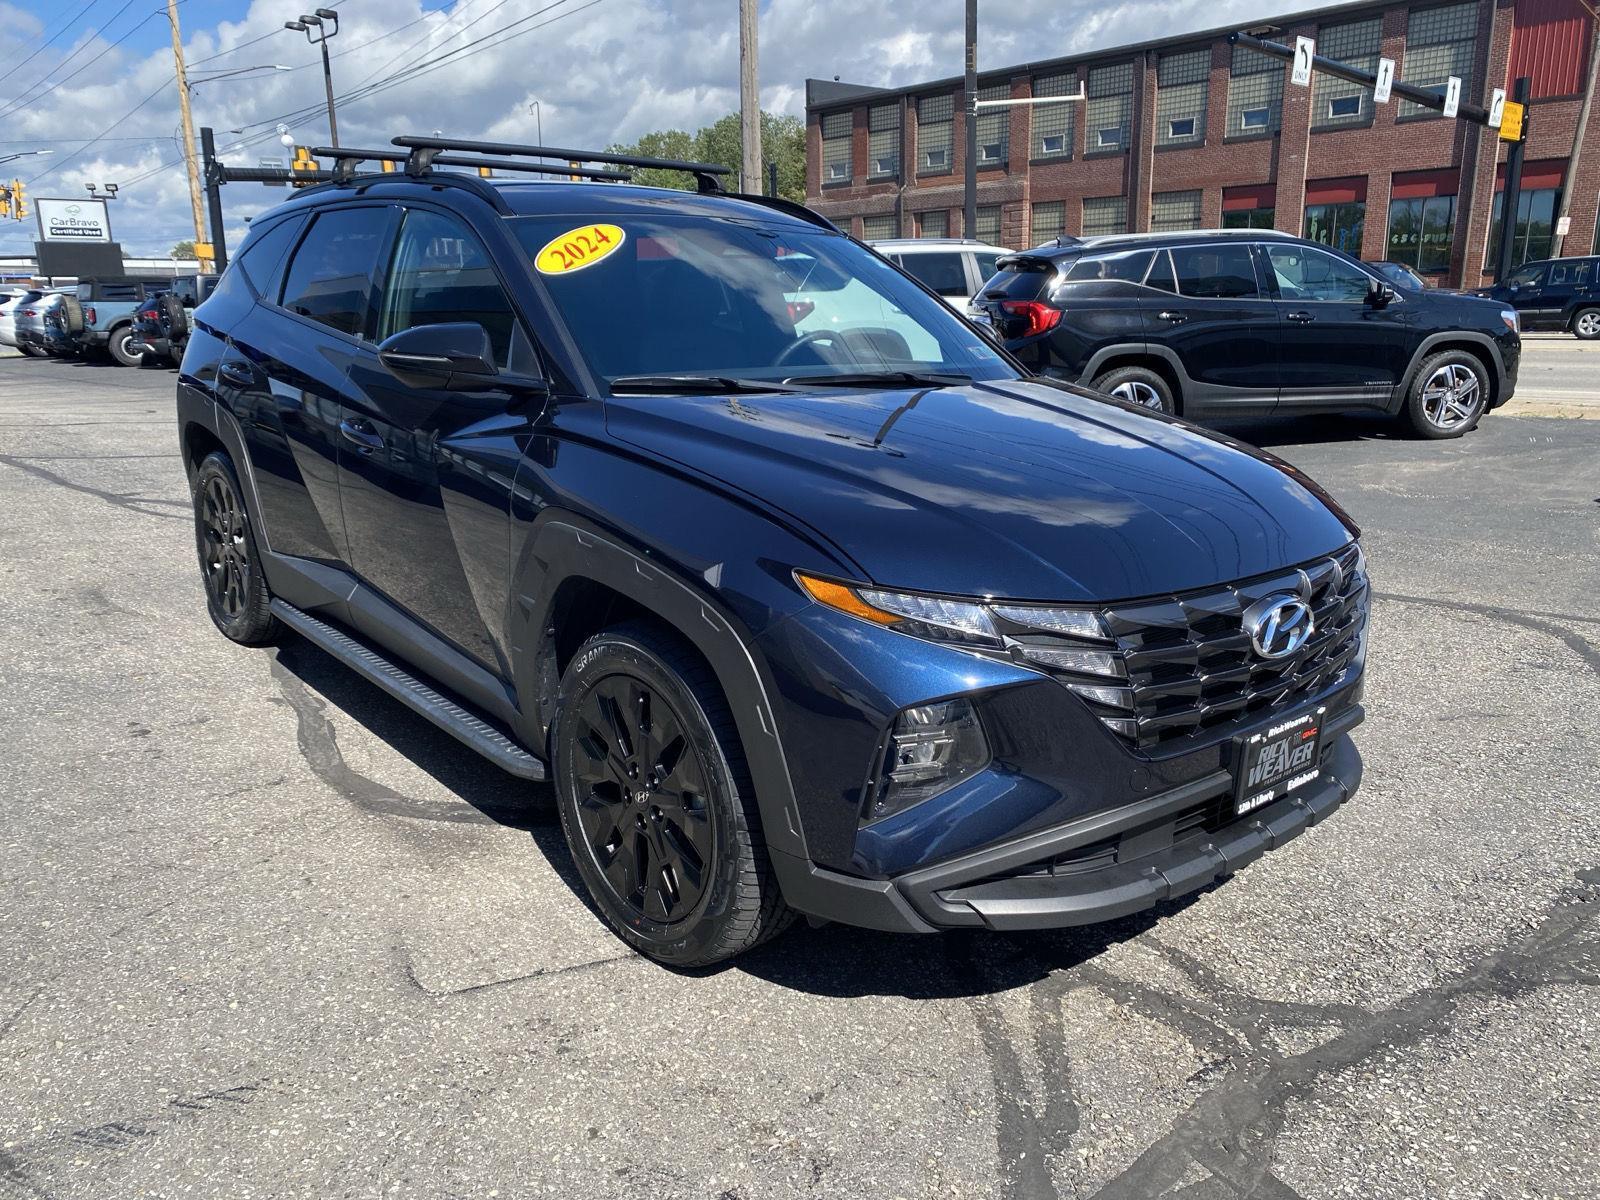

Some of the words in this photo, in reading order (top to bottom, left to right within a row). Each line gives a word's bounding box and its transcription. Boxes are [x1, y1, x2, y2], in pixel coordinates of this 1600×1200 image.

[1294, 70, 1308, 81] ONLY
[51, 217, 99, 226] CarBravo
[550, 228, 611, 269] 2024
[1248, 740, 1315, 787] WEAVER
[1258, 737, 1292, 765] RICK
